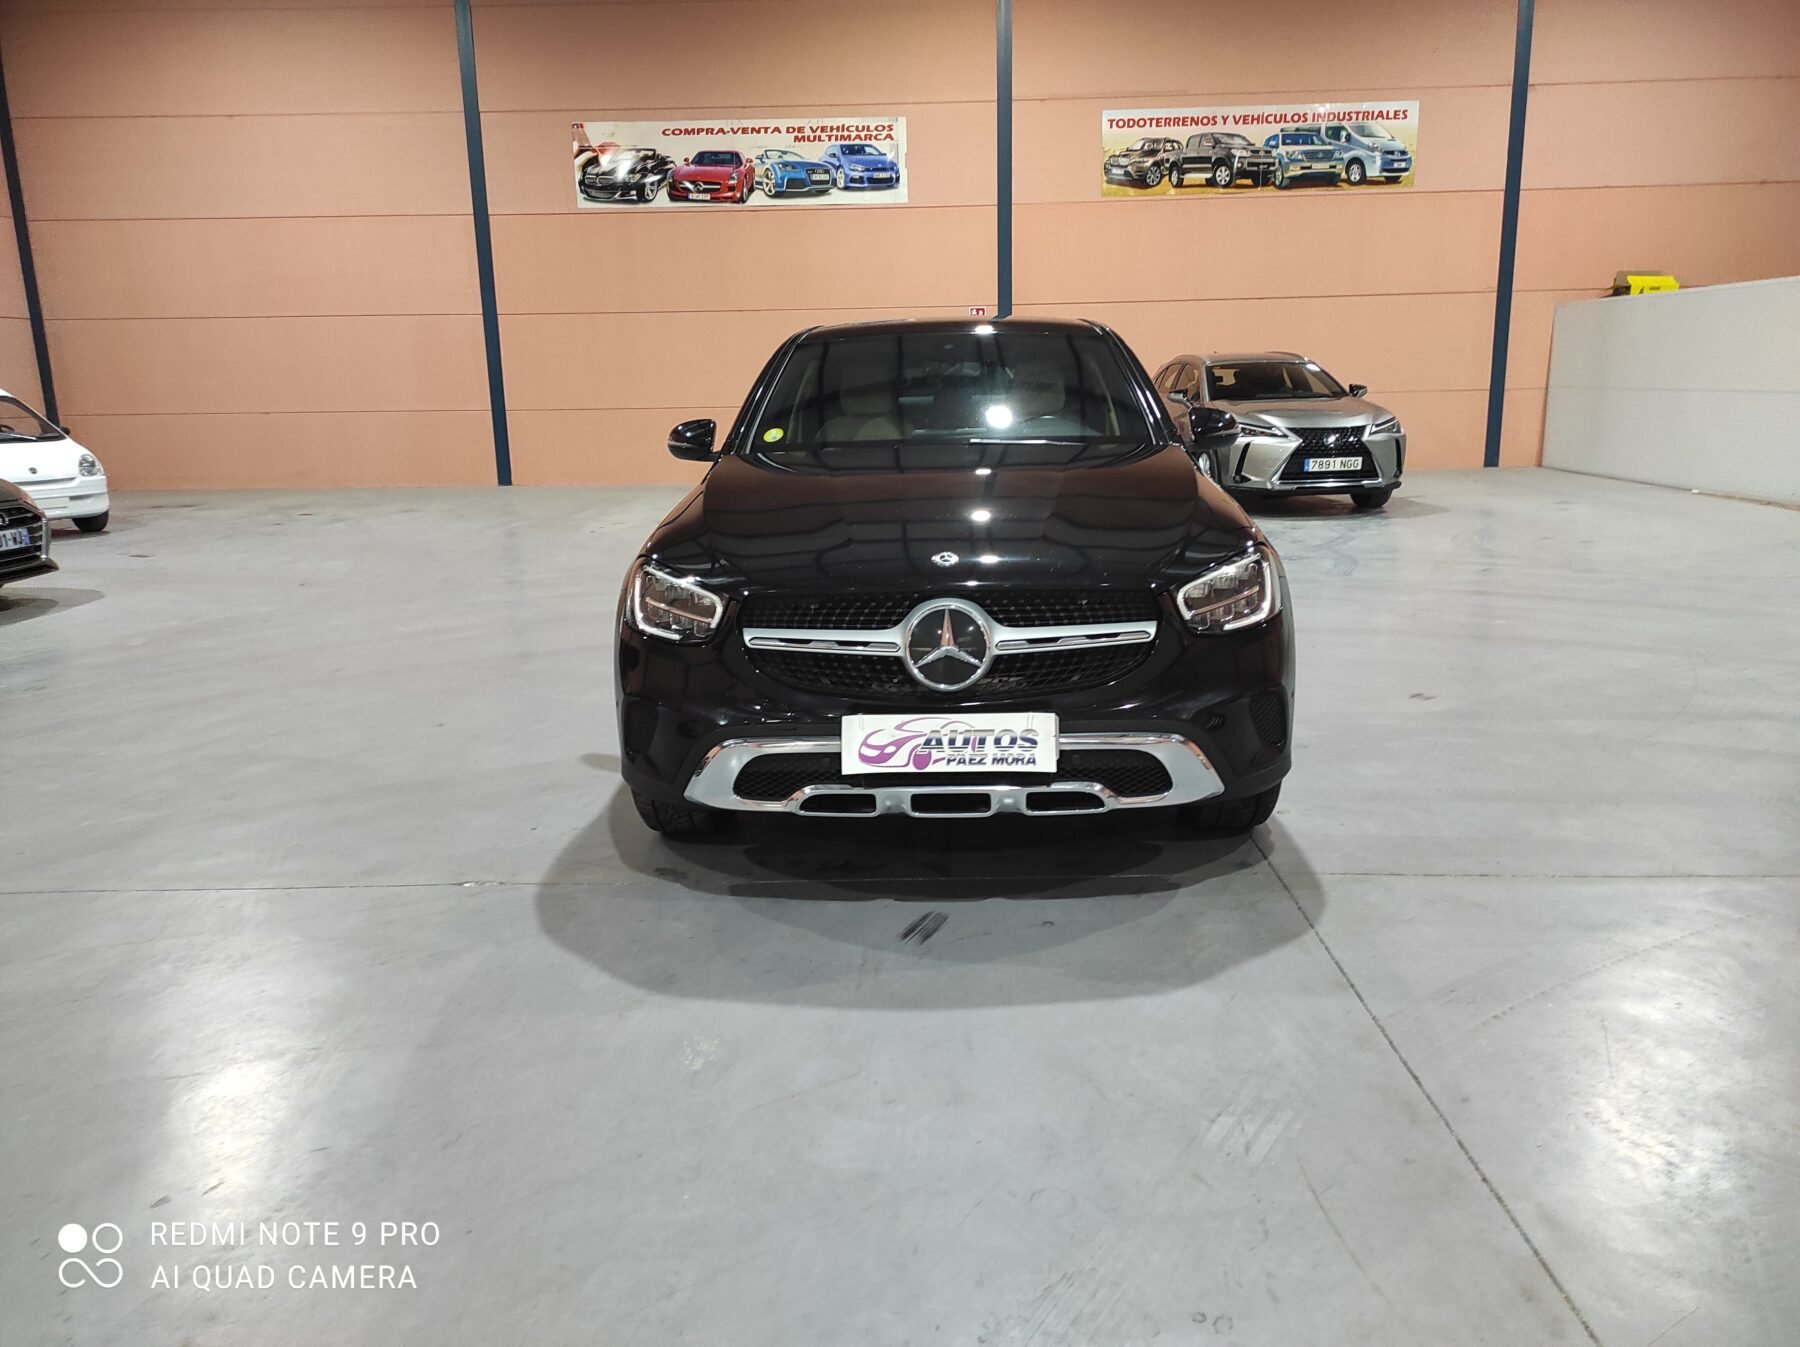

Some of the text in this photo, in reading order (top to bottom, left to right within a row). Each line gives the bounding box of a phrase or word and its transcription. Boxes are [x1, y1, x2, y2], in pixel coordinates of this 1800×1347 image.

[1107, 109, 1409, 129] TODOTERRENOS Y VEHÍCULOS INDUSTRIALES
[661, 123, 894, 137] COMPRA-VENTA DE VEHÍCULOS
[793, 133, 894, 143] MULTIMARCA
[1311, 458, 1360, 470] 7891 NGG
[920, 729, 1039, 753] AUTOS
[991, 753, 1037, 766] MORA
